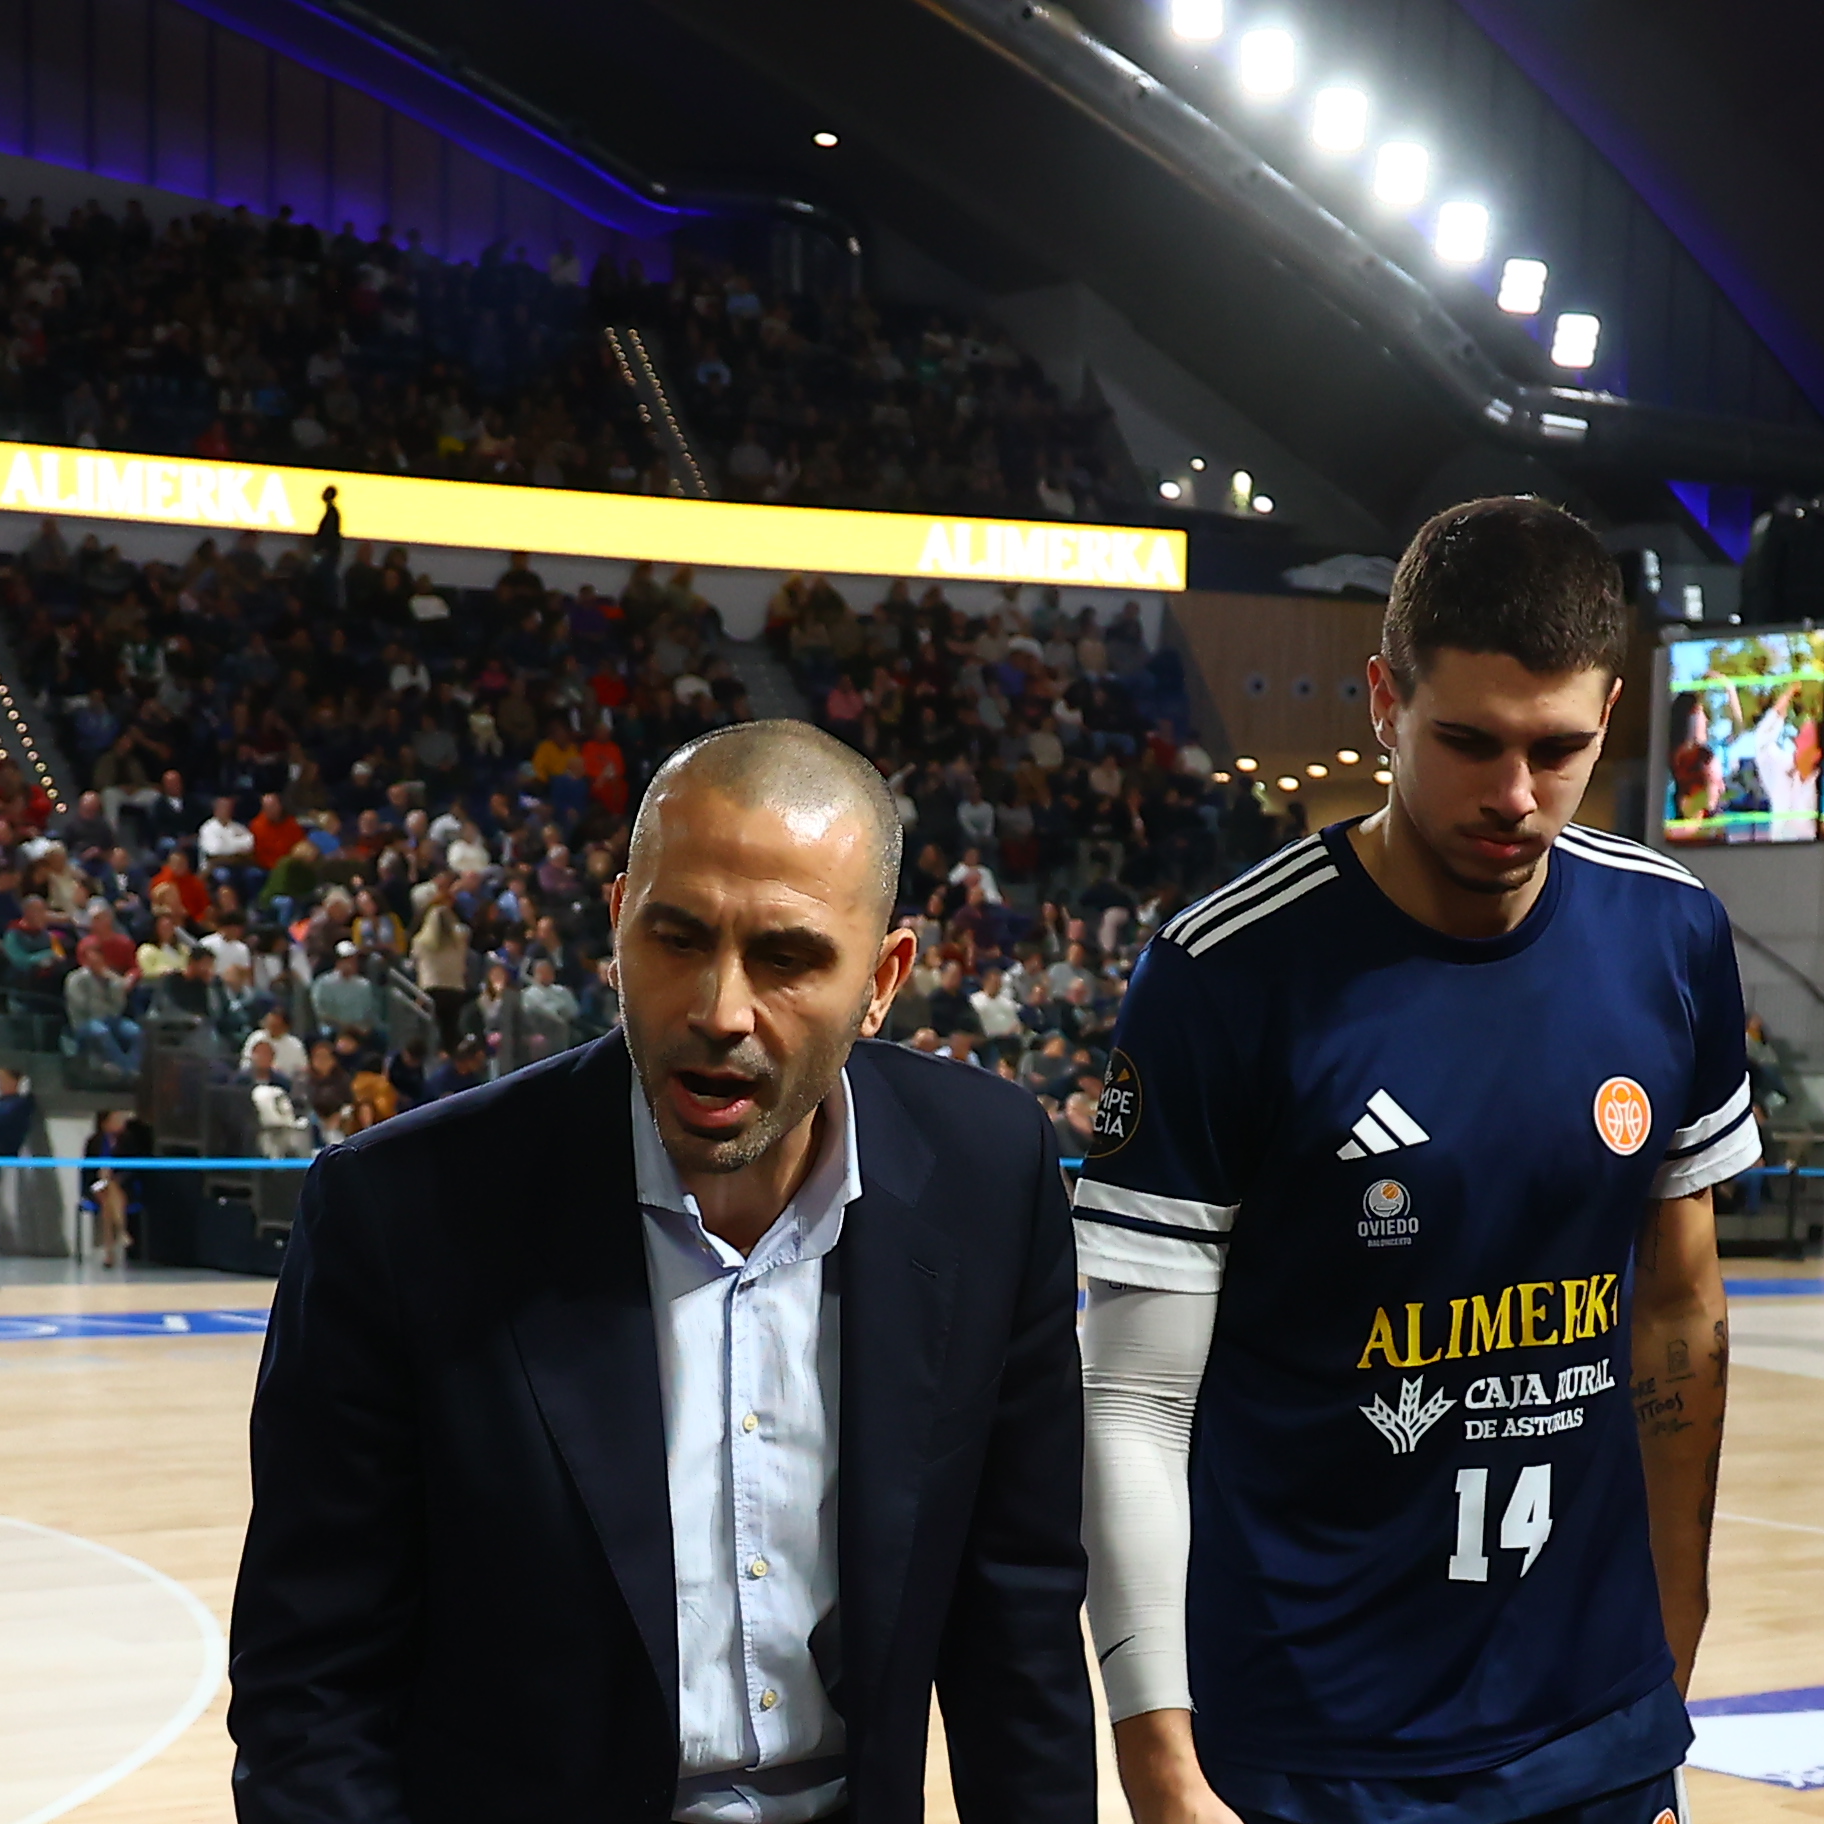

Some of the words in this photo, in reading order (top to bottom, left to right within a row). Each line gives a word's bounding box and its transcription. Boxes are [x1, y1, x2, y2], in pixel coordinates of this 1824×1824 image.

[0, 450, 296, 527] ALIMERKA
[917, 521, 1182, 587] ALIMERKA
[1357, 1217, 1420, 1237] OVIEDO
[1356, 1273, 1619, 1369] ALIMERK
[1464, 1373, 1552, 1410] CAJA
[1554, 1358, 1616, 1404] RURAL
[1464, 1418, 1498, 1440] DE
[1501, 1407, 1585, 1438] ASTURIAS
[1448, 1462, 1553, 1584] 14
